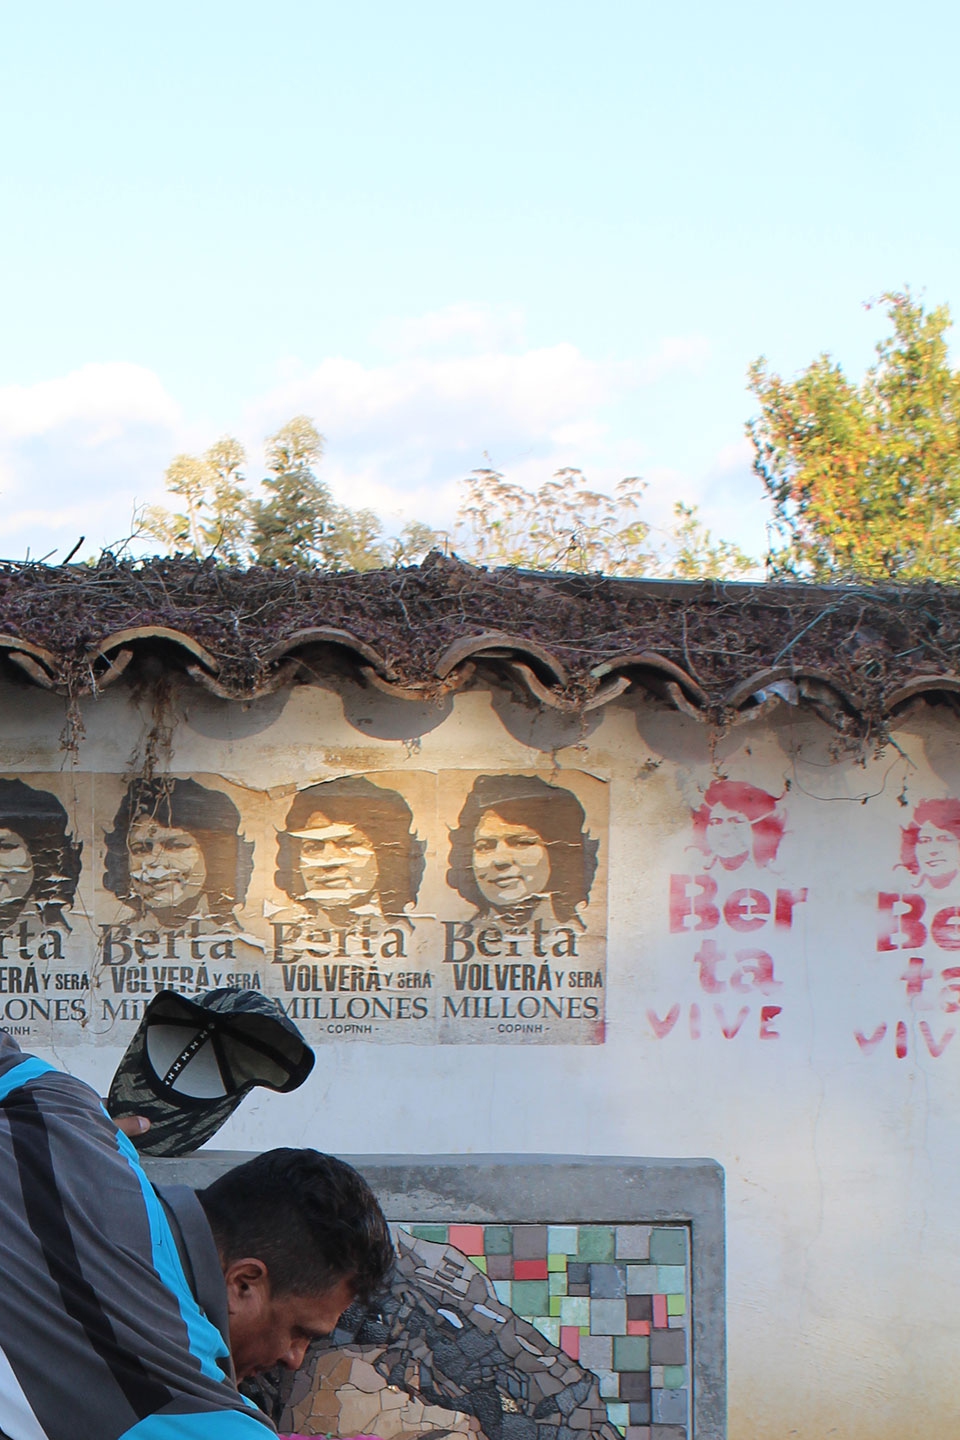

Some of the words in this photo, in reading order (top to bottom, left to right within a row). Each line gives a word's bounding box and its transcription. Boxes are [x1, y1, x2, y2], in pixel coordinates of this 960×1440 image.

[669, 873, 809, 934] Ber
[876, 891, 960, 952] Be
[98, 919, 237, 967] Berta
[269, 918, 408, 965] Berta
[440, 917, 580, 964] Berta
[41, 973, 52, 990] Y
[55, 971, 90, 990] SERÁ
[111, 962, 210, 994] VOLVERÁ
[213, 973, 223, 988] Y
[227, 970, 261, 990] SERÁ
[282, 960, 382, 992] VOLVERÁ
[383, 971, 394, 987] Y
[397, 969, 432, 989] SERÁ
[453, 960, 553, 992] VOLVERÁ
[555, 971, 565, 988] Y
[568, 969, 603, 988] SERÁ
[694, 939, 783, 996] ta
[271, 996, 429, 1020] MILLONES
[442, 996, 600, 1020] MILLONES
[647, 1003, 783, 1040] VIVE
[327, 1024, 372, 1034] COPINH
[497, 1024, 543, 1033] COPINH
[853, 1020, 958, 1059] VIV
